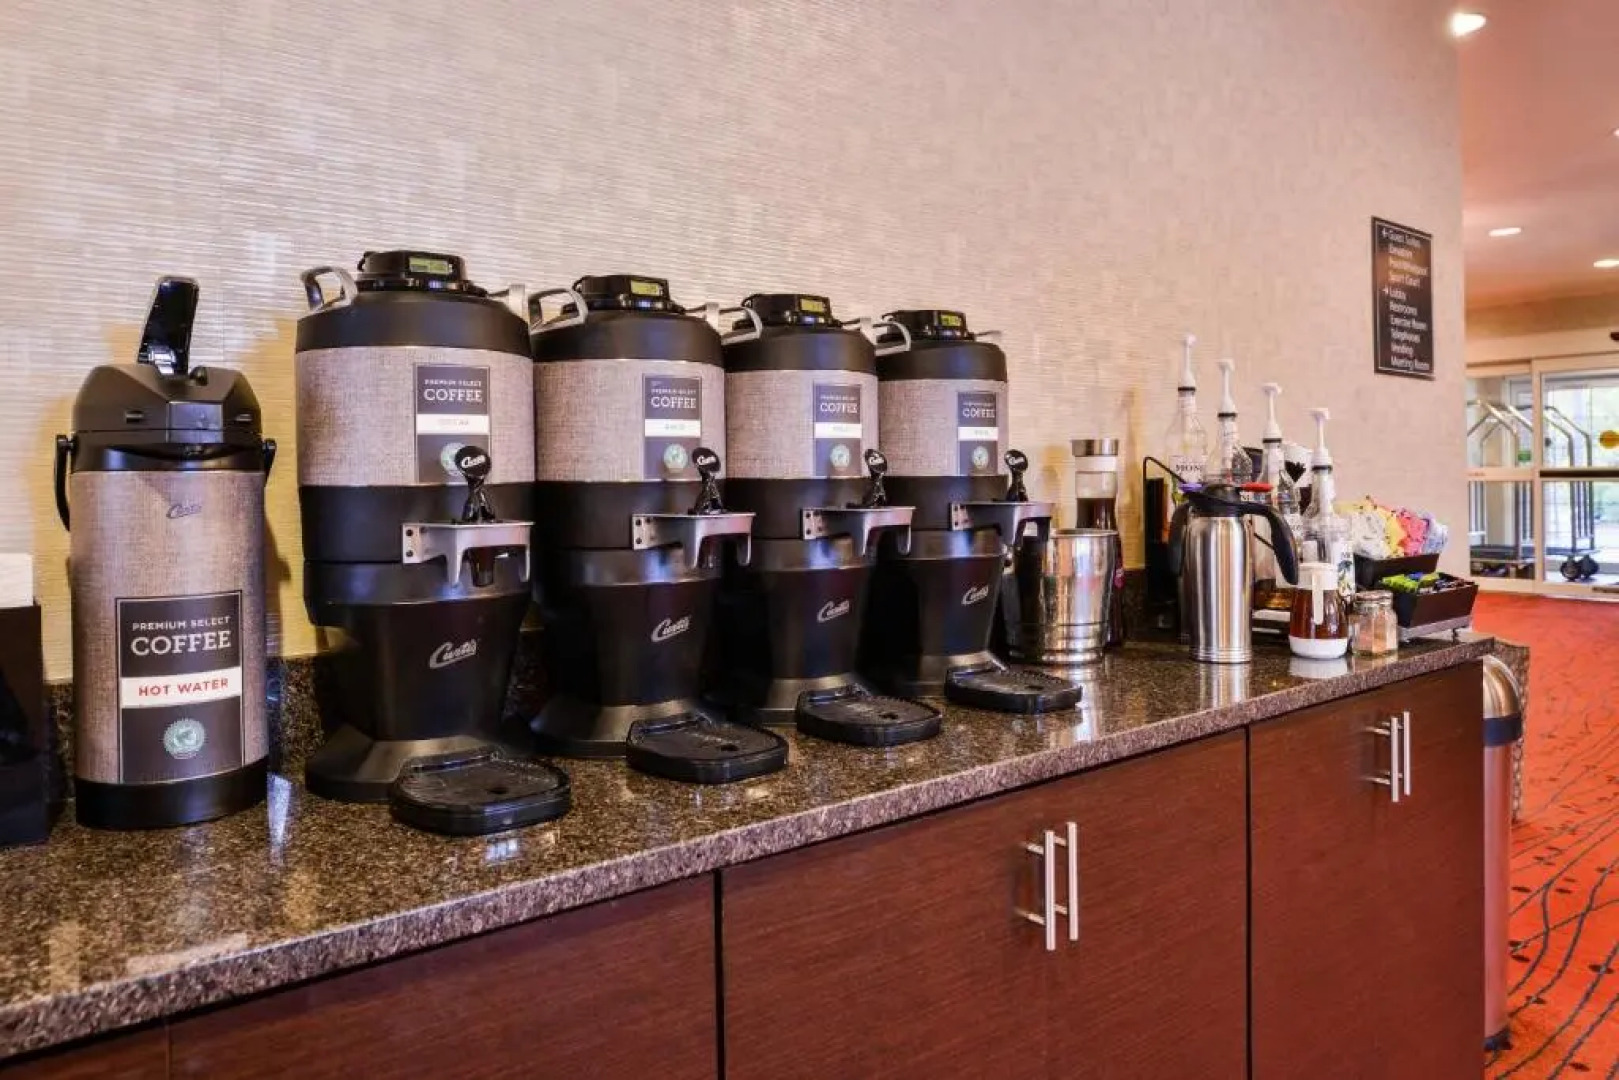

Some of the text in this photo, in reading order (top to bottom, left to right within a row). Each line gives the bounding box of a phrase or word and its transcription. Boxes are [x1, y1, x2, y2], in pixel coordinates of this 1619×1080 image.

[423, 388, 483, 403] COFFEE
[651, 396, 697, 409] COFFEE
[820, 402, 859, 414] COFFEE
[962, 407, 996, 419] COFFEE
[132, 616, 231, 631] PREMIUM SELECT
[131, 630, 232, 656] COFFEE
[429, 639, 478, 669] Curtis
[138, 678, 229, 697] HOT WATER
